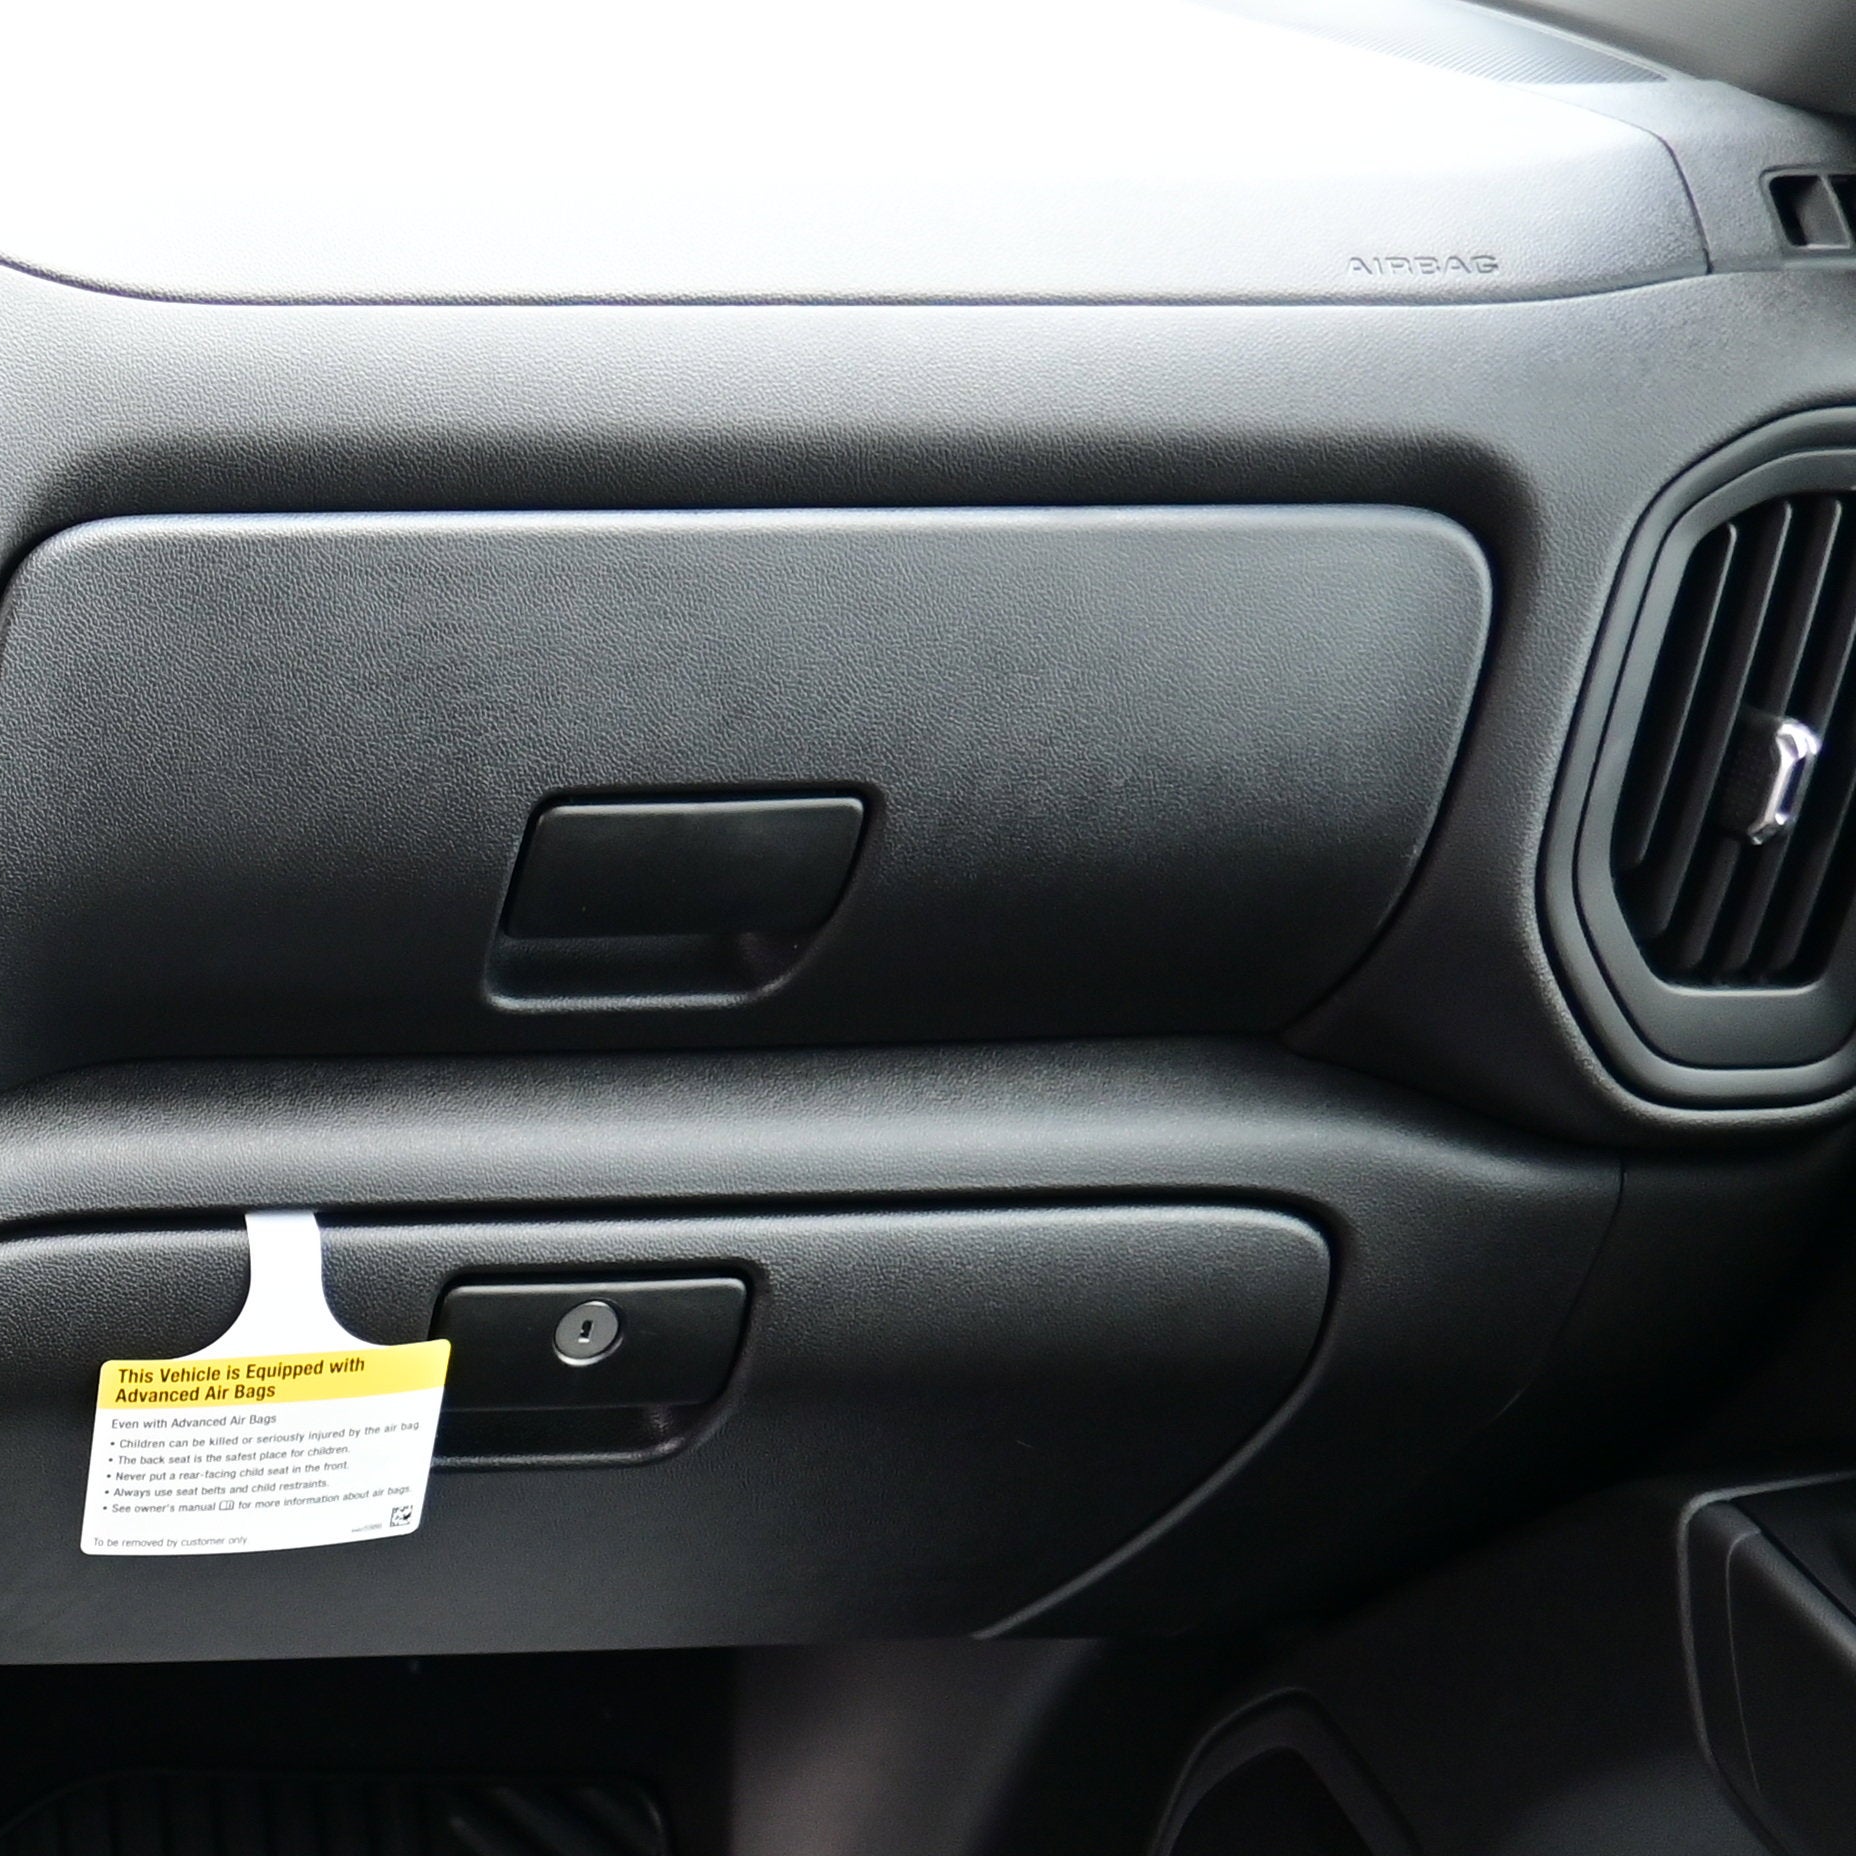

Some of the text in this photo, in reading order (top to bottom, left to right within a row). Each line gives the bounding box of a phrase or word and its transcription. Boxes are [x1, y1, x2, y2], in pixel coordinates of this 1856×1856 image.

[1348, 256, 1499, 274] AIRBAG
[120, 1358, 364, 1383] This Vehicle is Equipped with
[116, 1385, 275, 1402] Advanced Air Bags
[111, 1414, 277, 1429] Even with Advanced Air Bags
[119, 1439, 166, 1449] Children
[168, 1439, 189, 1448] can
[192, 1438, 206, 1448] be
[208, 1436, 239, 1446] killed
[241, 1436, 253, 1445] or
[256, 1432, 305, 1444] seriously
[308, 1428, 346, 1441] injured
[348, 1428, 361, 1438] by
[364, 1426, 381, 1436] the
[383, 1424, 397, 1433] air
[118, 1455, 137, 1465] The
[139, 1455, 165, 1465] back
[168, 1455, 191, 1464] seat
[193, 1455, 203, 1464] is
[205, 1453, 223, 1463] the
[225, 1451, 257, 1462] safest
[259, 1450, 288, 1462] place
[290, 1448, 305, 1458] for
